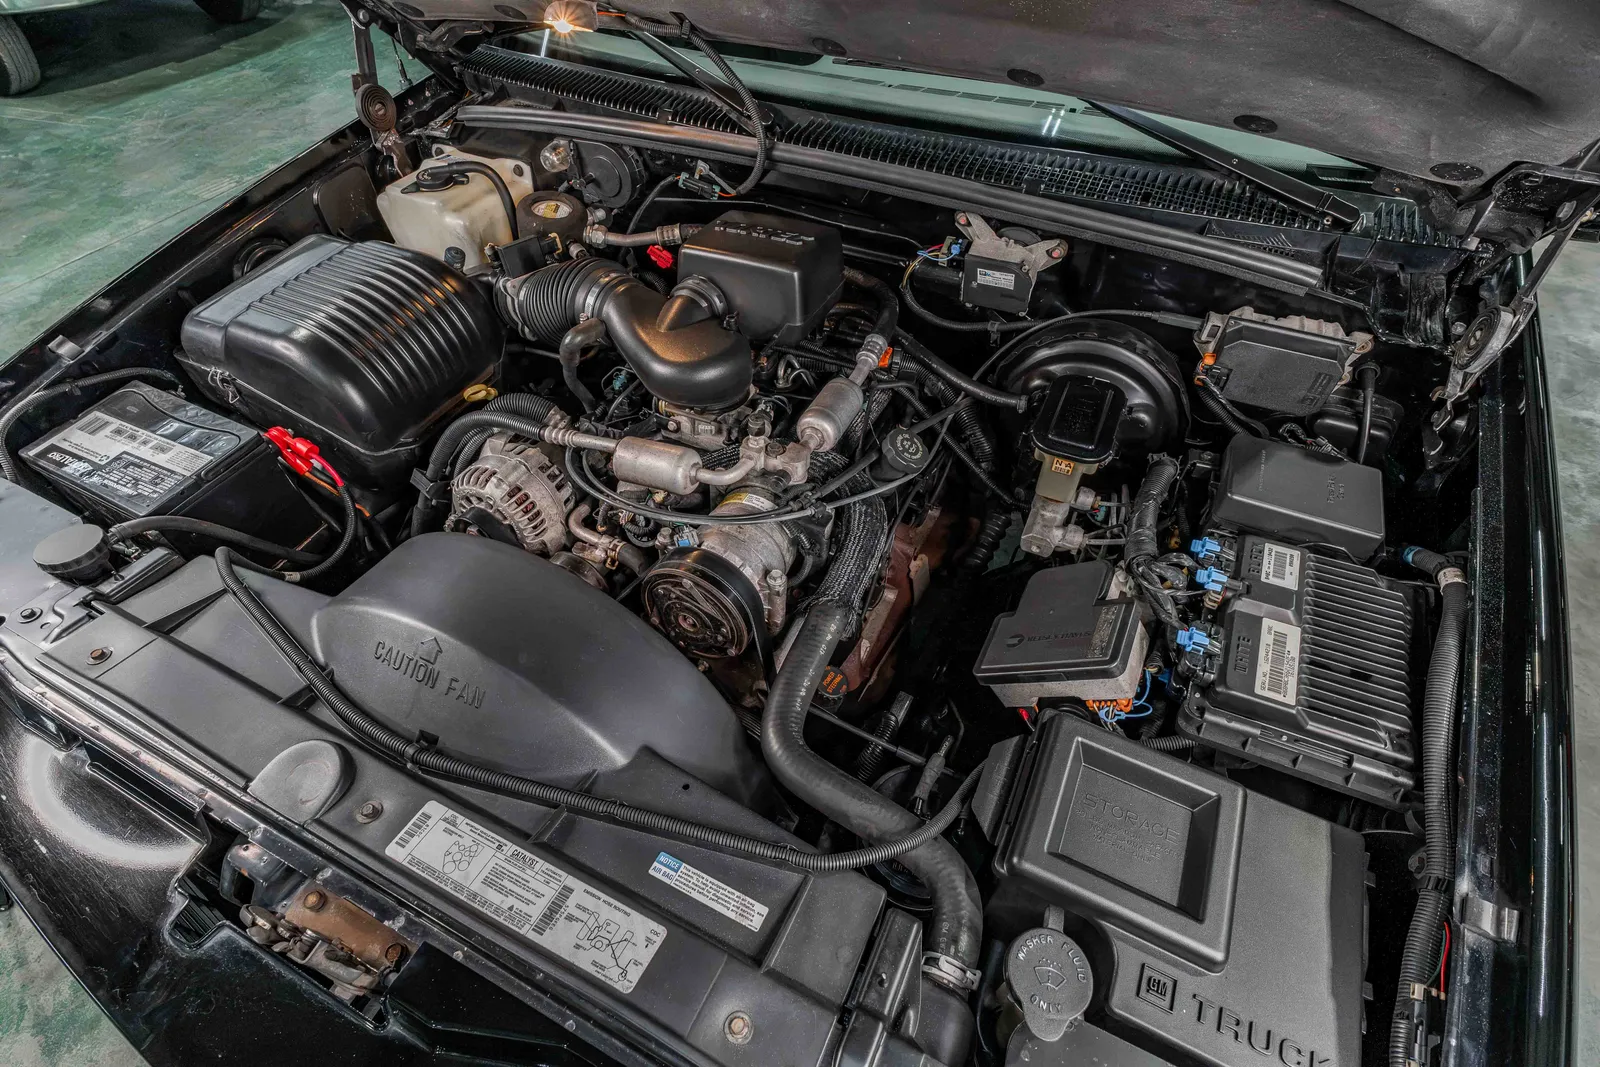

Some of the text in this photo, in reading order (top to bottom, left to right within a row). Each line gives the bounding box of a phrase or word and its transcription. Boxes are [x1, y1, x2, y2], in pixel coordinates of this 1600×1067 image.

[373, 640, 486, 709] CAUTION FAN
[821, 670, 835, 686] POWER
[826, 672, 843, 693] STEERING
[1083, 793, 1181, 846] STORAGE
[510, 848, 539, 868] CATALYST
[651, 864, 674, 881] AIR BAG
[658, 854, 679, 870] NOTICE
[673, 877, 697, 892] procedures
[695, 889, 709, 899] before
[707, 895, 731, 911] performing
[729, 907, 738, 915] any
[737, 911, 754, 923] service.
[676, 873, 691, 884] service
[690, 881, 706, 892] manual
[710, 891, 732, 906] diagnostic
[739, 907, 755, 918] service
[678, 869, 695, 881] system.
[699, 880, 709, 888] help
[708, 884, 720, 894] avoid
[719, 891, 740, 904] unwanted
[681, 865, 691, 873] This
[690, 870, 705, 880] vehicle
[707, 879, 727, 894] equipped
[726, 889, 736, 897] with
[746, 900, 755, 908] bag
[582, 888, 631, 917] EMISSION HOSE ROUTING
[649, 928, 661, 937] CDC
[1016, 933, 1086, 982] WASHER FLUID
[1147, 975, 1169, 999] GM
[1030, 993, 1060, 1012] ONLY
[1192, 993, 1331, 1067] TRUCK
